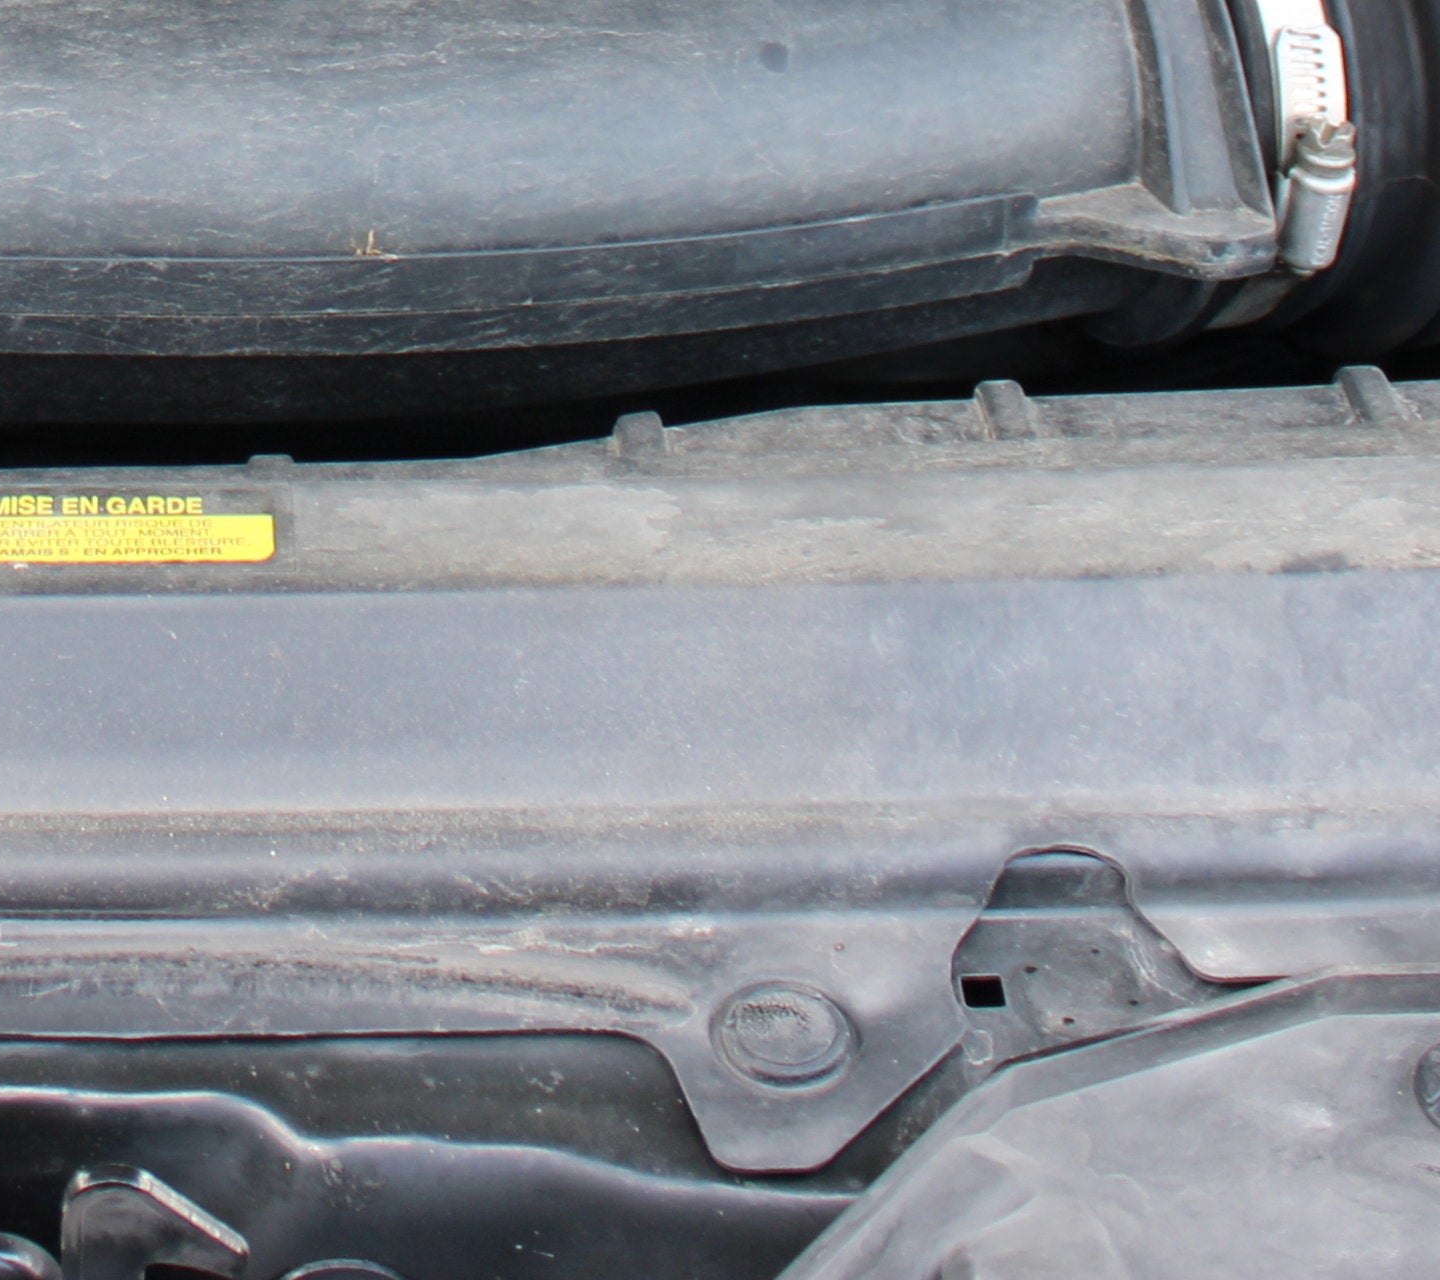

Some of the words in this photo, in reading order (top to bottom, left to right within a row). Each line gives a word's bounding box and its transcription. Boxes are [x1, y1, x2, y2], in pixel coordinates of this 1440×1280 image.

[62, 496, 99, 515] EN
[106, 496, 203, 515] GARDE
[116, 519, 182, 529] RISQUE
[188, 519, 213, 529] DE
[83, 528, 126, 538] TOUT
[83, 538, 143, 547] TOUTE
[83, 547, 107, 556] EN
[112, 547, 222, 556] APPROCHER
